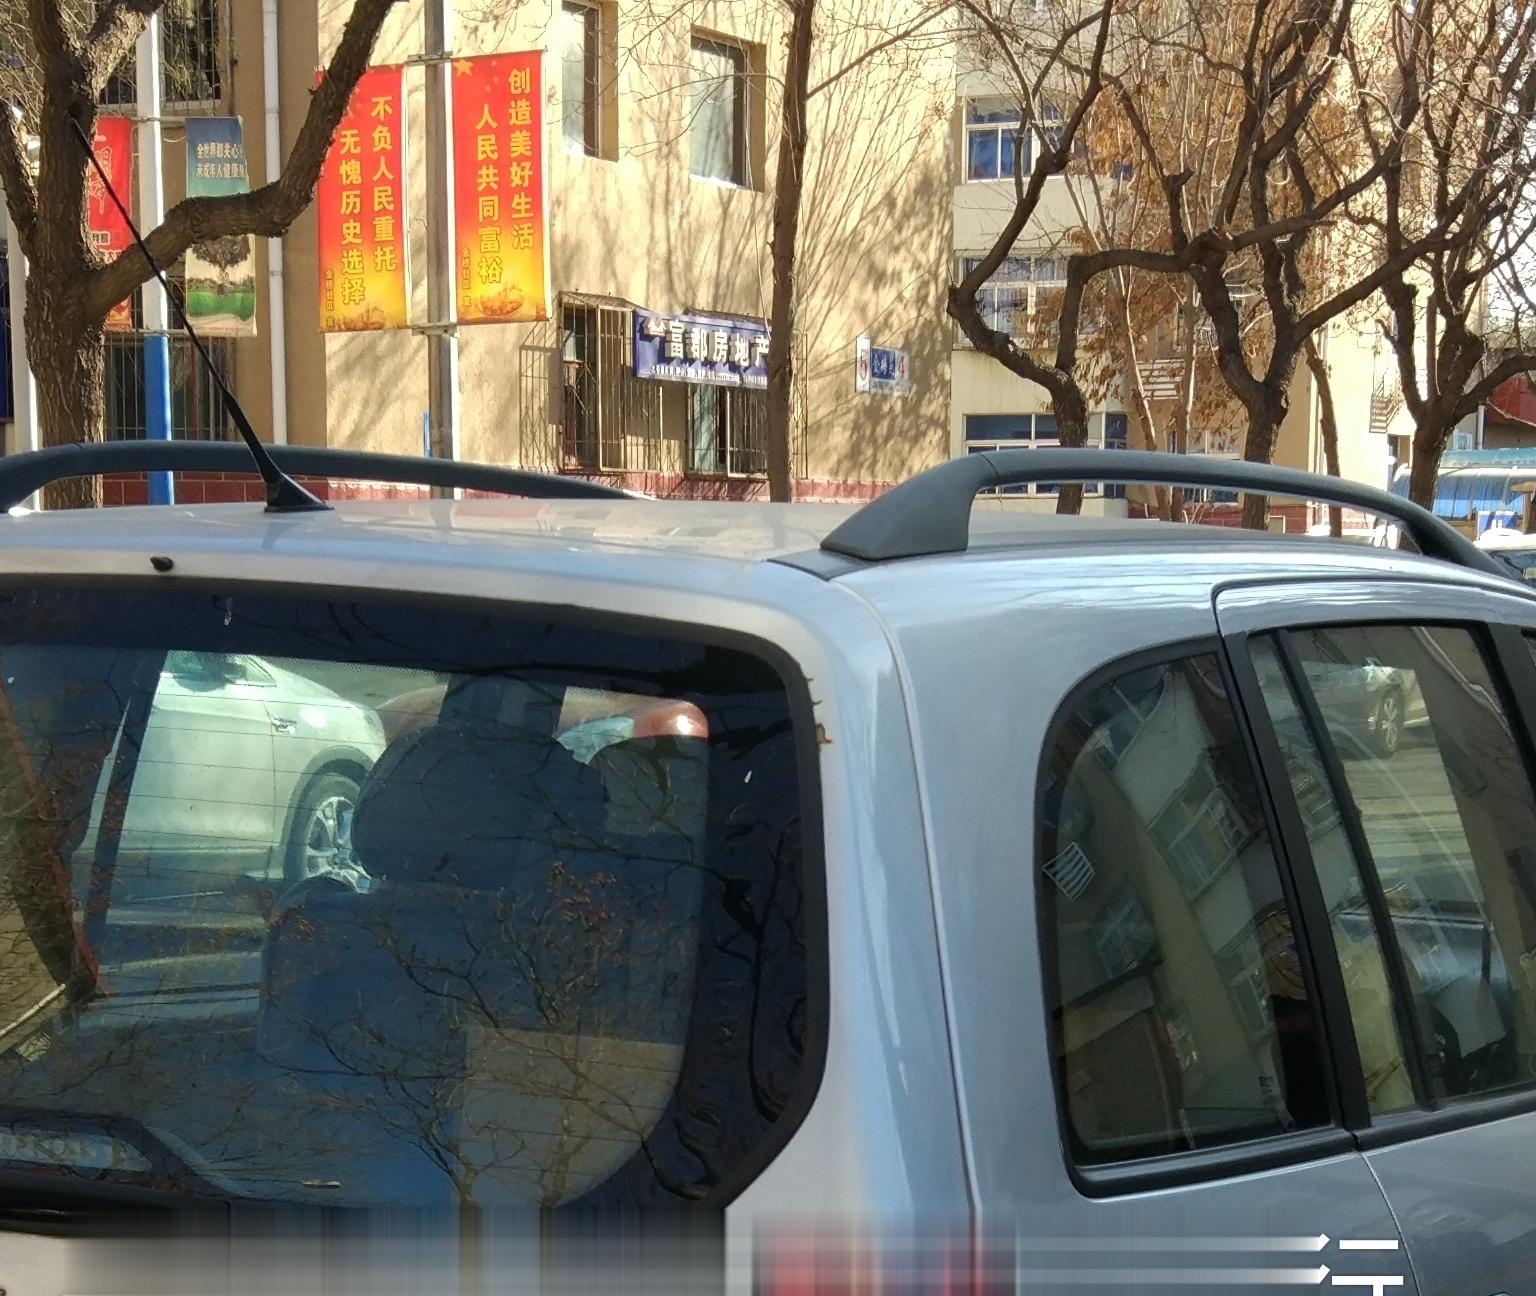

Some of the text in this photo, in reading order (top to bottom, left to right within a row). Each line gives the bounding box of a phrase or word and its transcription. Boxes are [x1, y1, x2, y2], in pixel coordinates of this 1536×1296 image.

[339, 129, 365, 305] 无愧历史选择
[370, 96, 396, 272] 不负人民重托
[476, 104, 502, 284] 人民共同富裕
[508, 67, 534, 249] 创造美好生活
[668, 320, 770, 367] 富郡房地产
